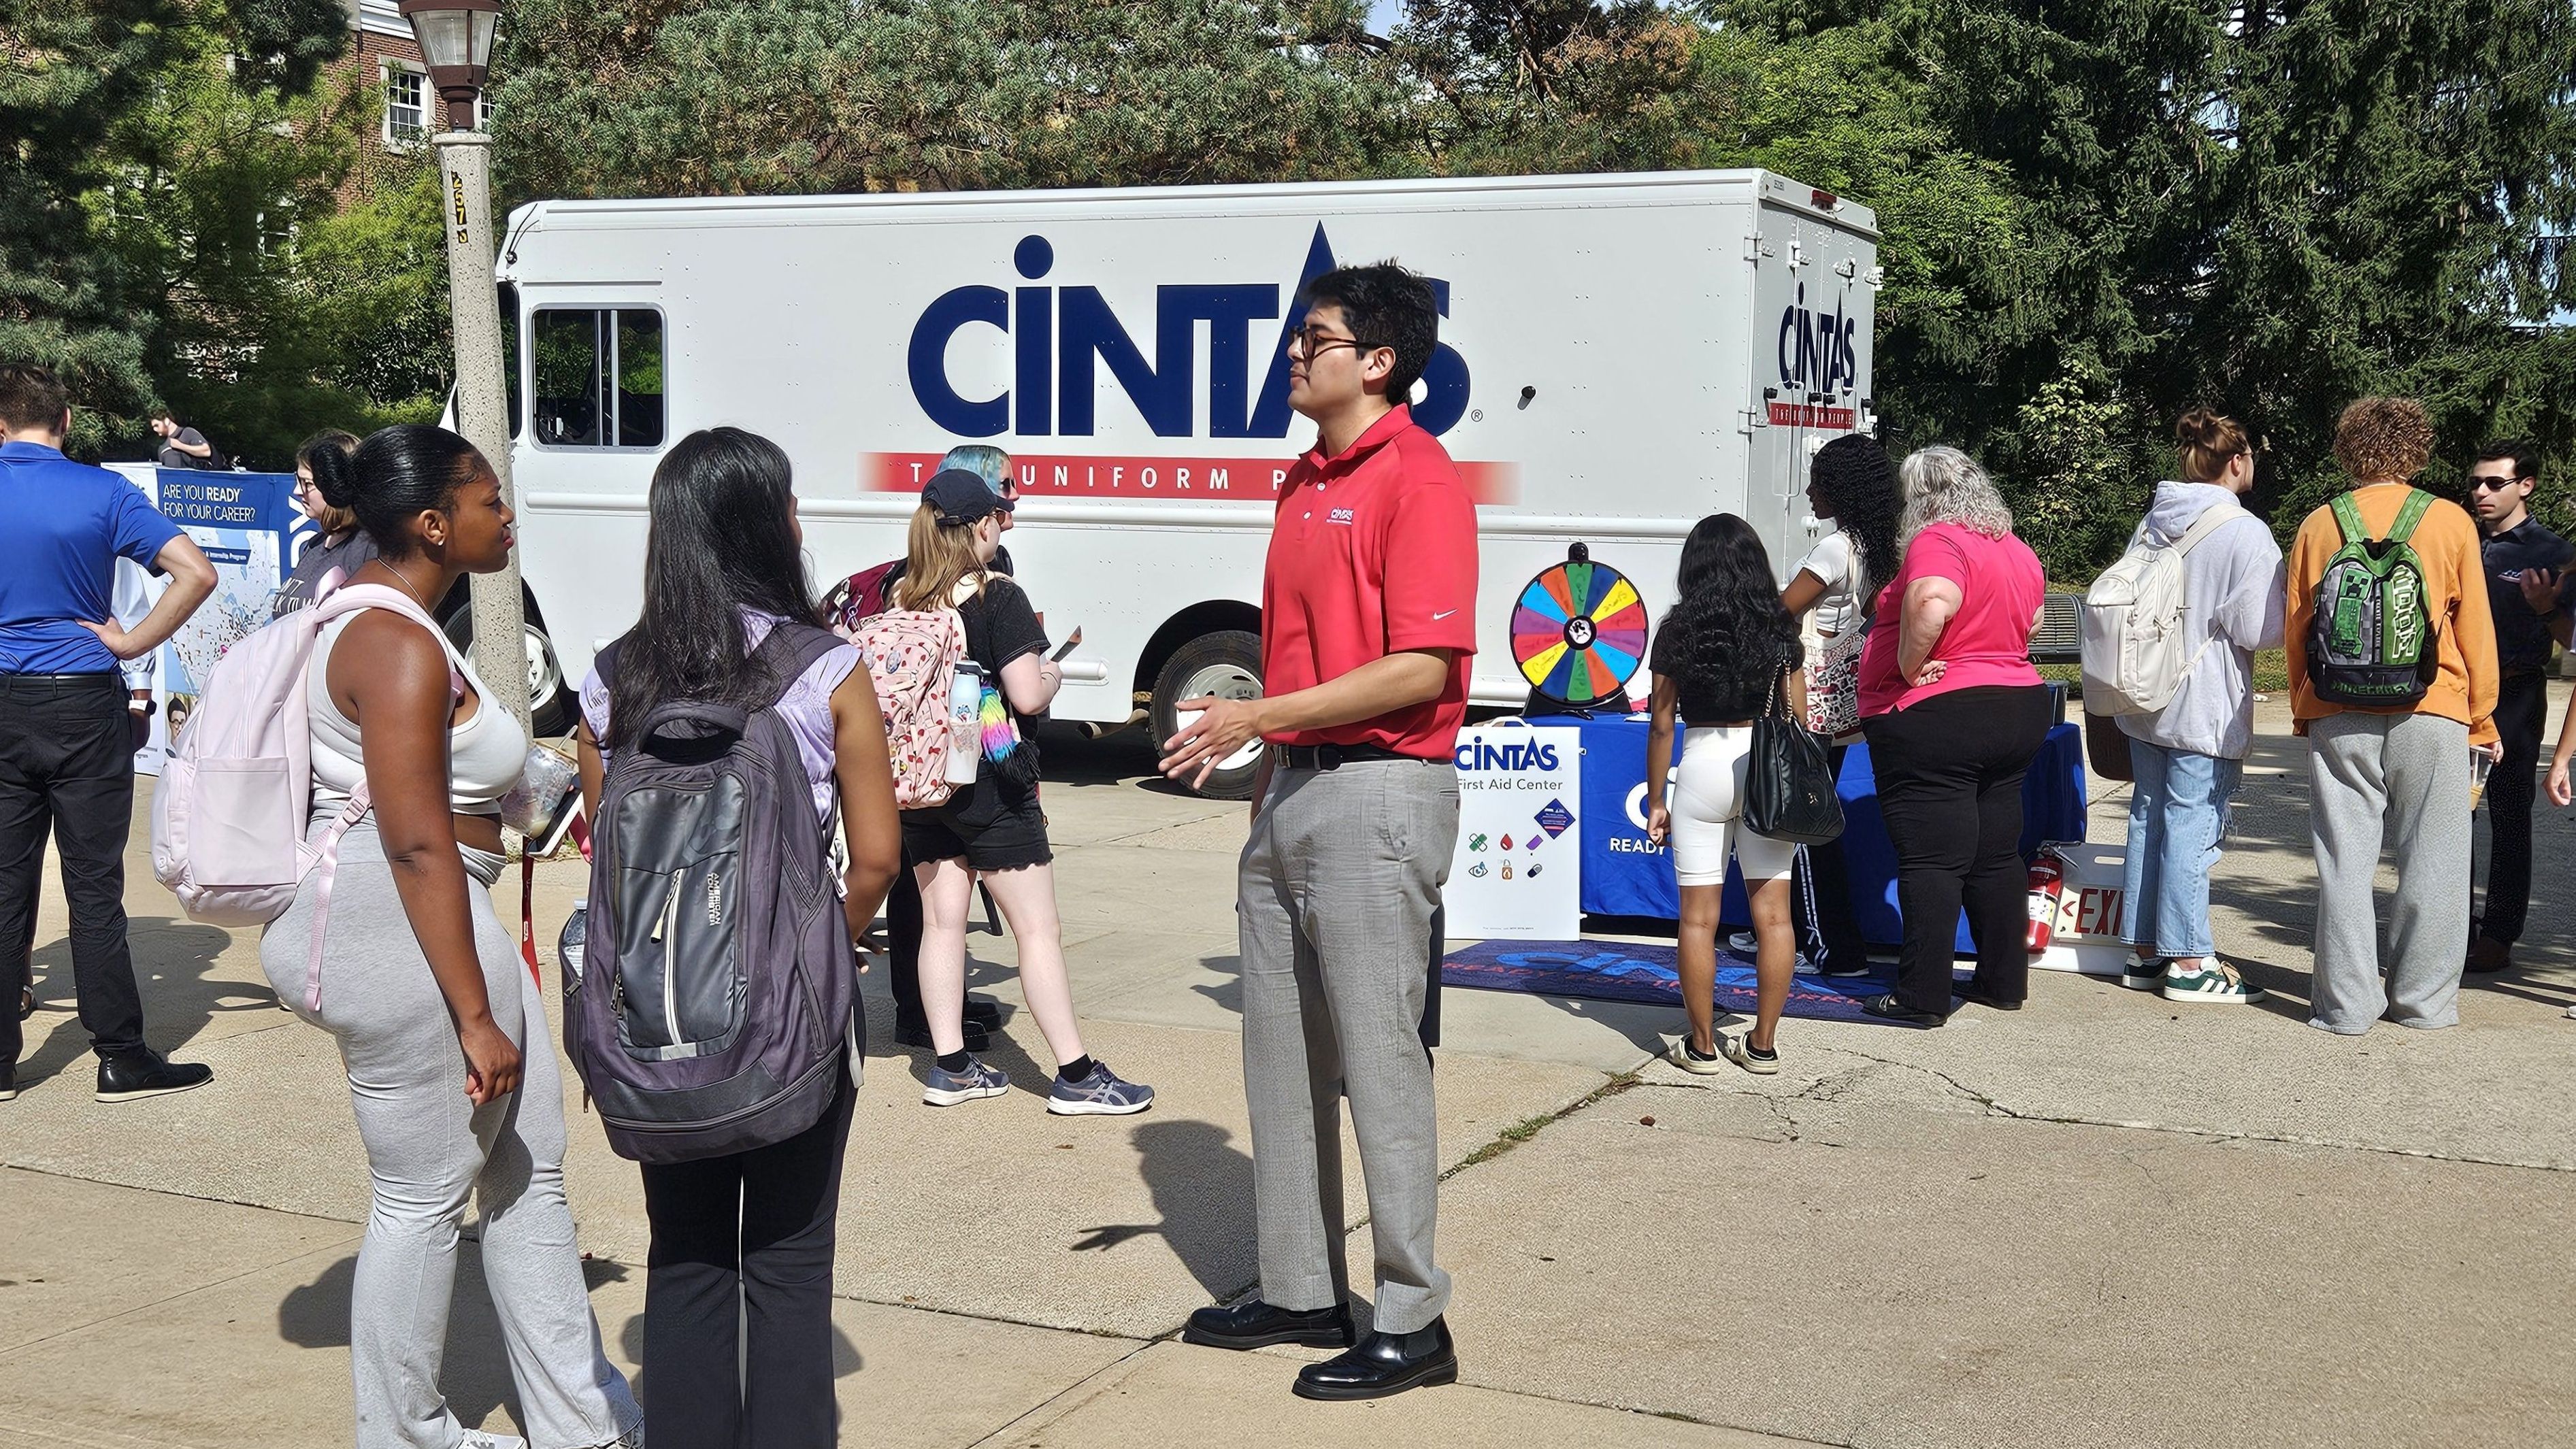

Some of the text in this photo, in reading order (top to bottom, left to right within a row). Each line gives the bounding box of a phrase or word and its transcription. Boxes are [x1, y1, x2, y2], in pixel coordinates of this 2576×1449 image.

[1022, 465, 1229, 490] UNIFORM
[163, 484, 240, 502] ARE YOU READY
[164, 502, 255, 522] FOR YOUR CAREER?
[1489, 778, 1511, 790] Aid
[1517, 778, 1563, 790] Center
[712, 872, 721, 925] AMERICAN
[2075, 888, 2124, 937] EXI
